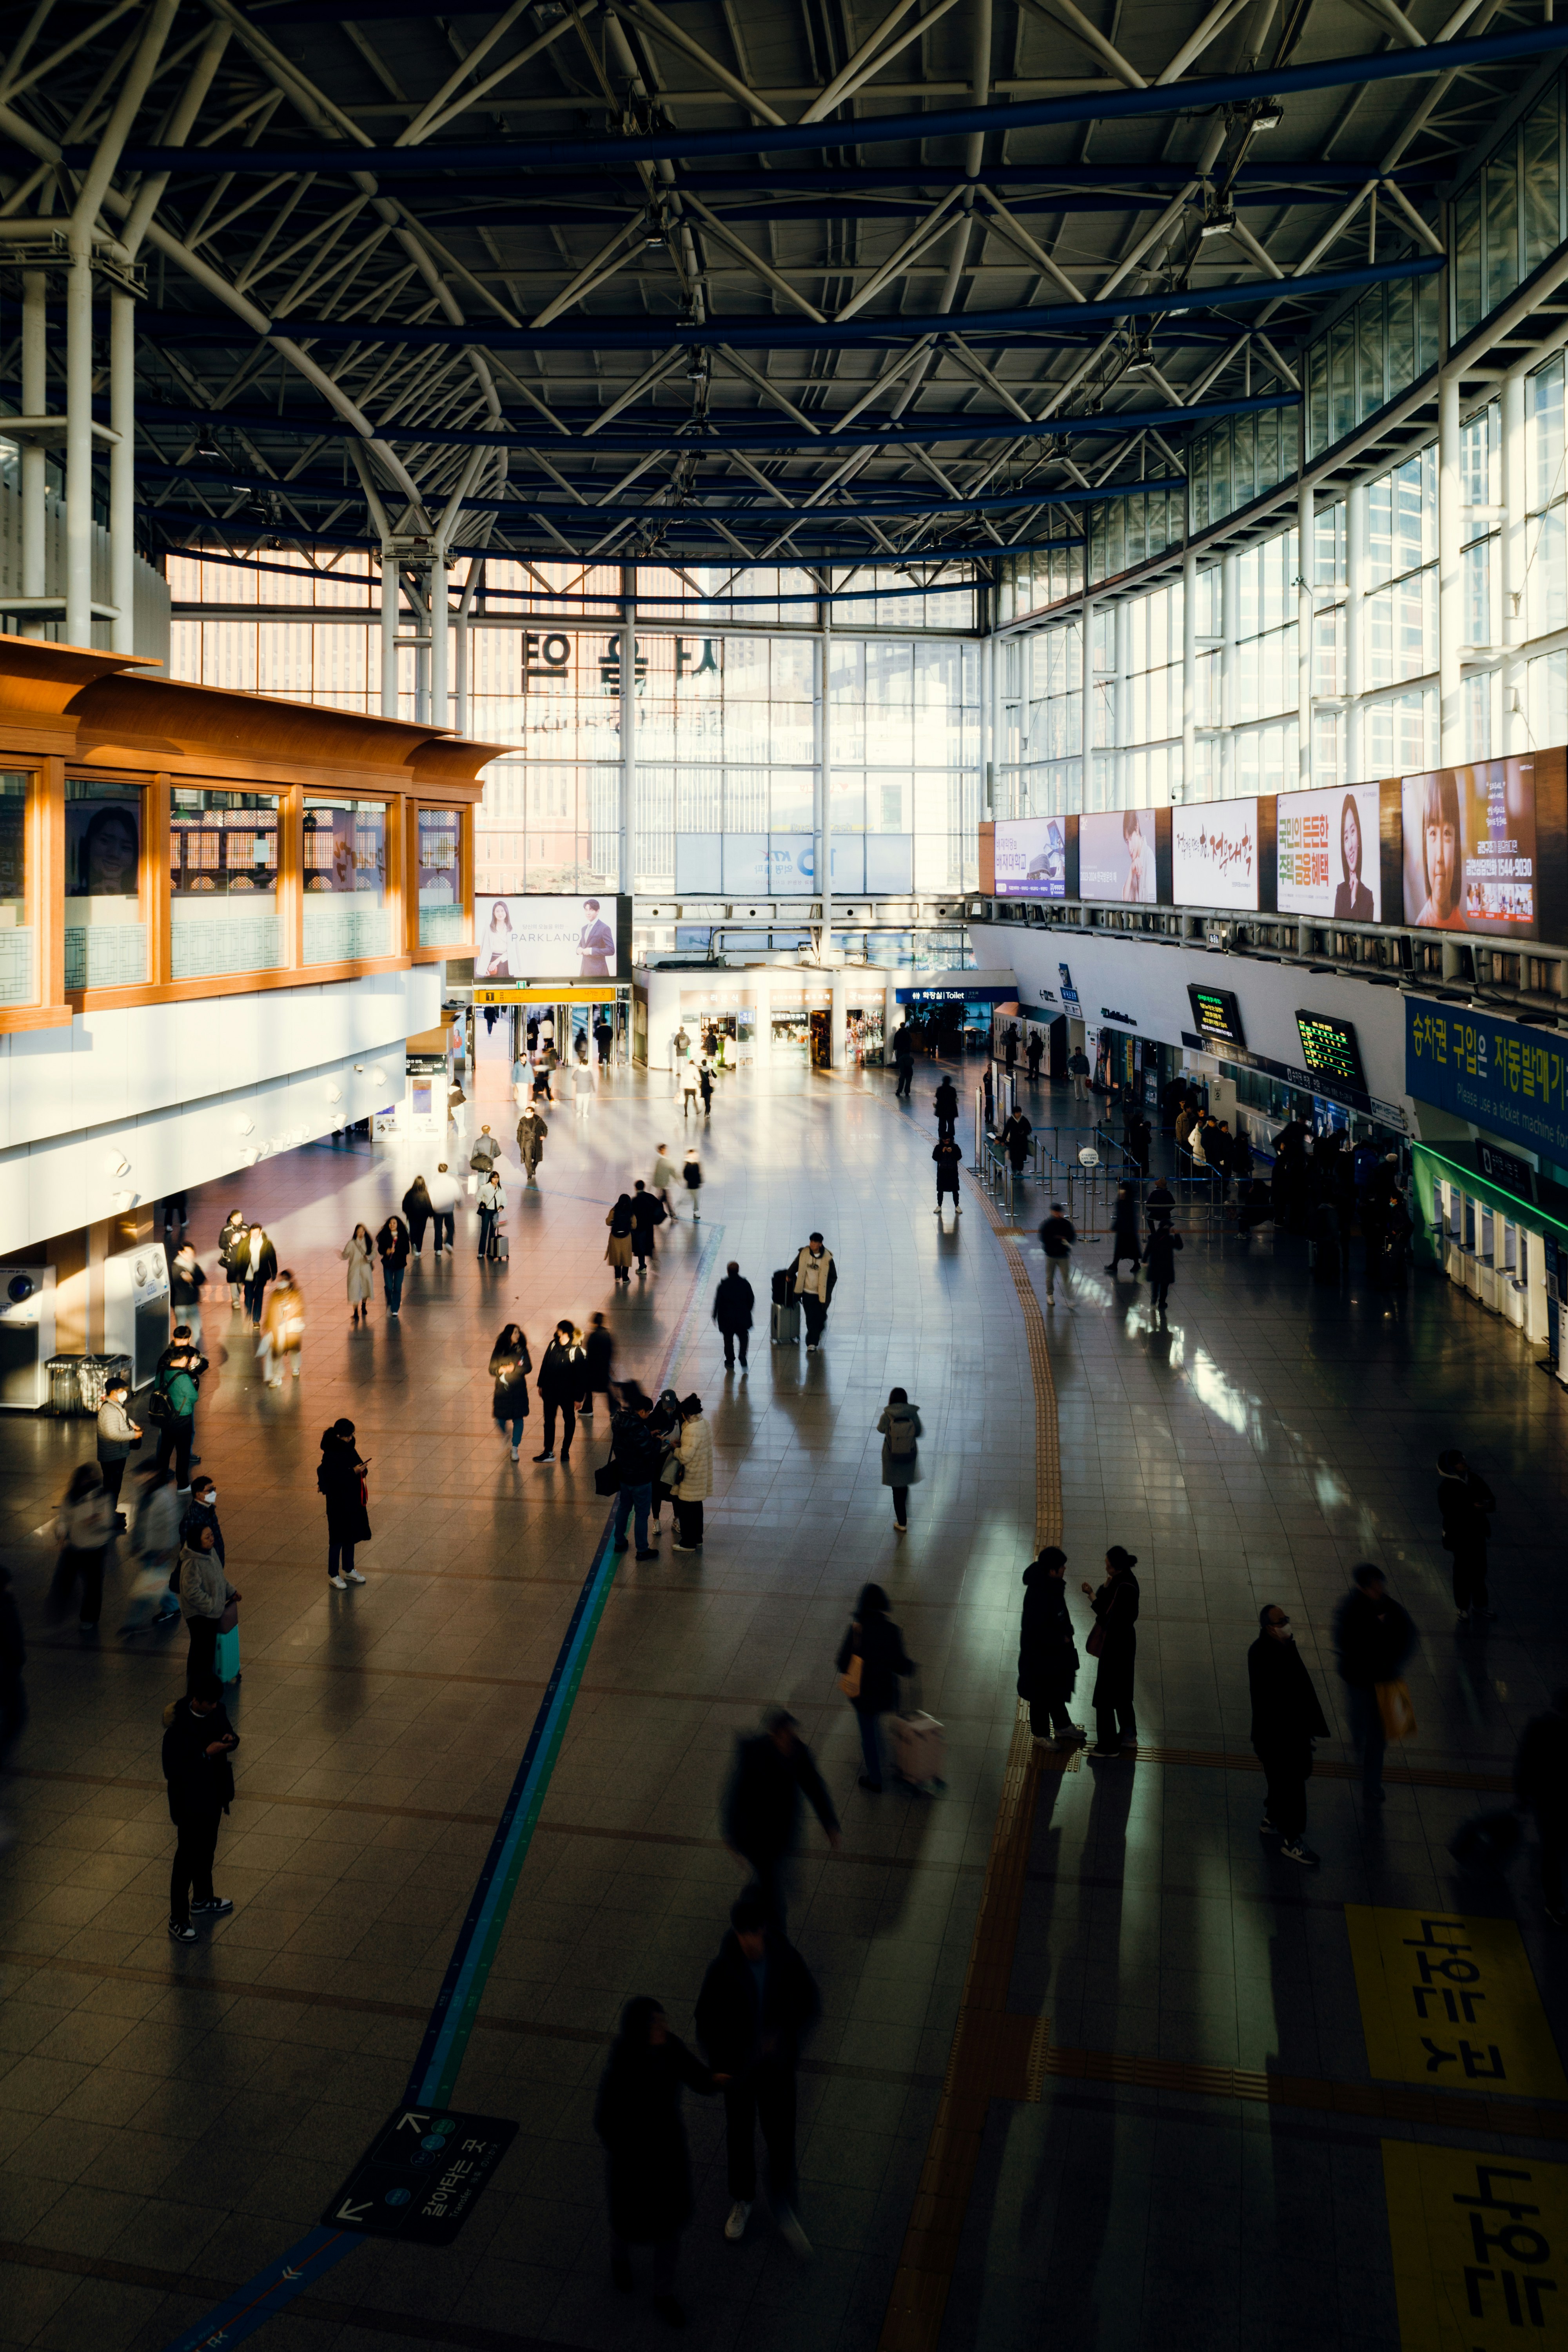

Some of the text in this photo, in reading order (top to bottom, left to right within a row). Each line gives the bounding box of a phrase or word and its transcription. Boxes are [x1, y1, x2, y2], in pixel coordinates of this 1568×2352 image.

[1279, 814, 1328, 849] 국민의 든든한
[996, 837, 1017, 851] 배재학당의
[1210, 822, 1252, 877] 전문대학
[1497, 840, 1518, 853] 필요하다면
[996, 853, 1026, 871] 배재대학교
[1279, 853, 1294, 885] 주택
[1081, 871, 1117, 883] 2023-2024 한국방문의 해
[511, 933, 580, 942] PARKLAND
[700, 994, 739, 1003] 누리분식
[923, 991, 943, 1000] 화장실
[1224, 1047, 1229, 1058] 곳
[1413, 1012, 1447, 1064] 승차권
[1453, 1024, 1488, 1078] 구입은
[1494, 1035, 1568, 1111] 자동발매기
[1292, 1070, 1303, 1085] 승차권
[1304, 1074, 1311, 1089] 변경
[1313, 1078, 1321, 1092] 반환
[1457, 1082, 1477, 1108] Please
[1479, 1096, 1491, 1114] use
[1493, 1103, 1497, 1116] a
[1499, 1101, 1520, 1126] ticket
[1522, 1114, 1555, 1143] machine
[1492, 1153, 1519, 1179] 승차권 사는 곳
[1402, 1919, 1507, 2080] 나오는 곳
[421, 2138, 487, 2218] 갈아타는 곳
[449, 2188, 473, 2218] Transfer
[481, 2143, 501, 2167] のりかえ
[1453, 2165, 1558, 2327] 나오는
[206, 2330, 229, 2348] 곳
